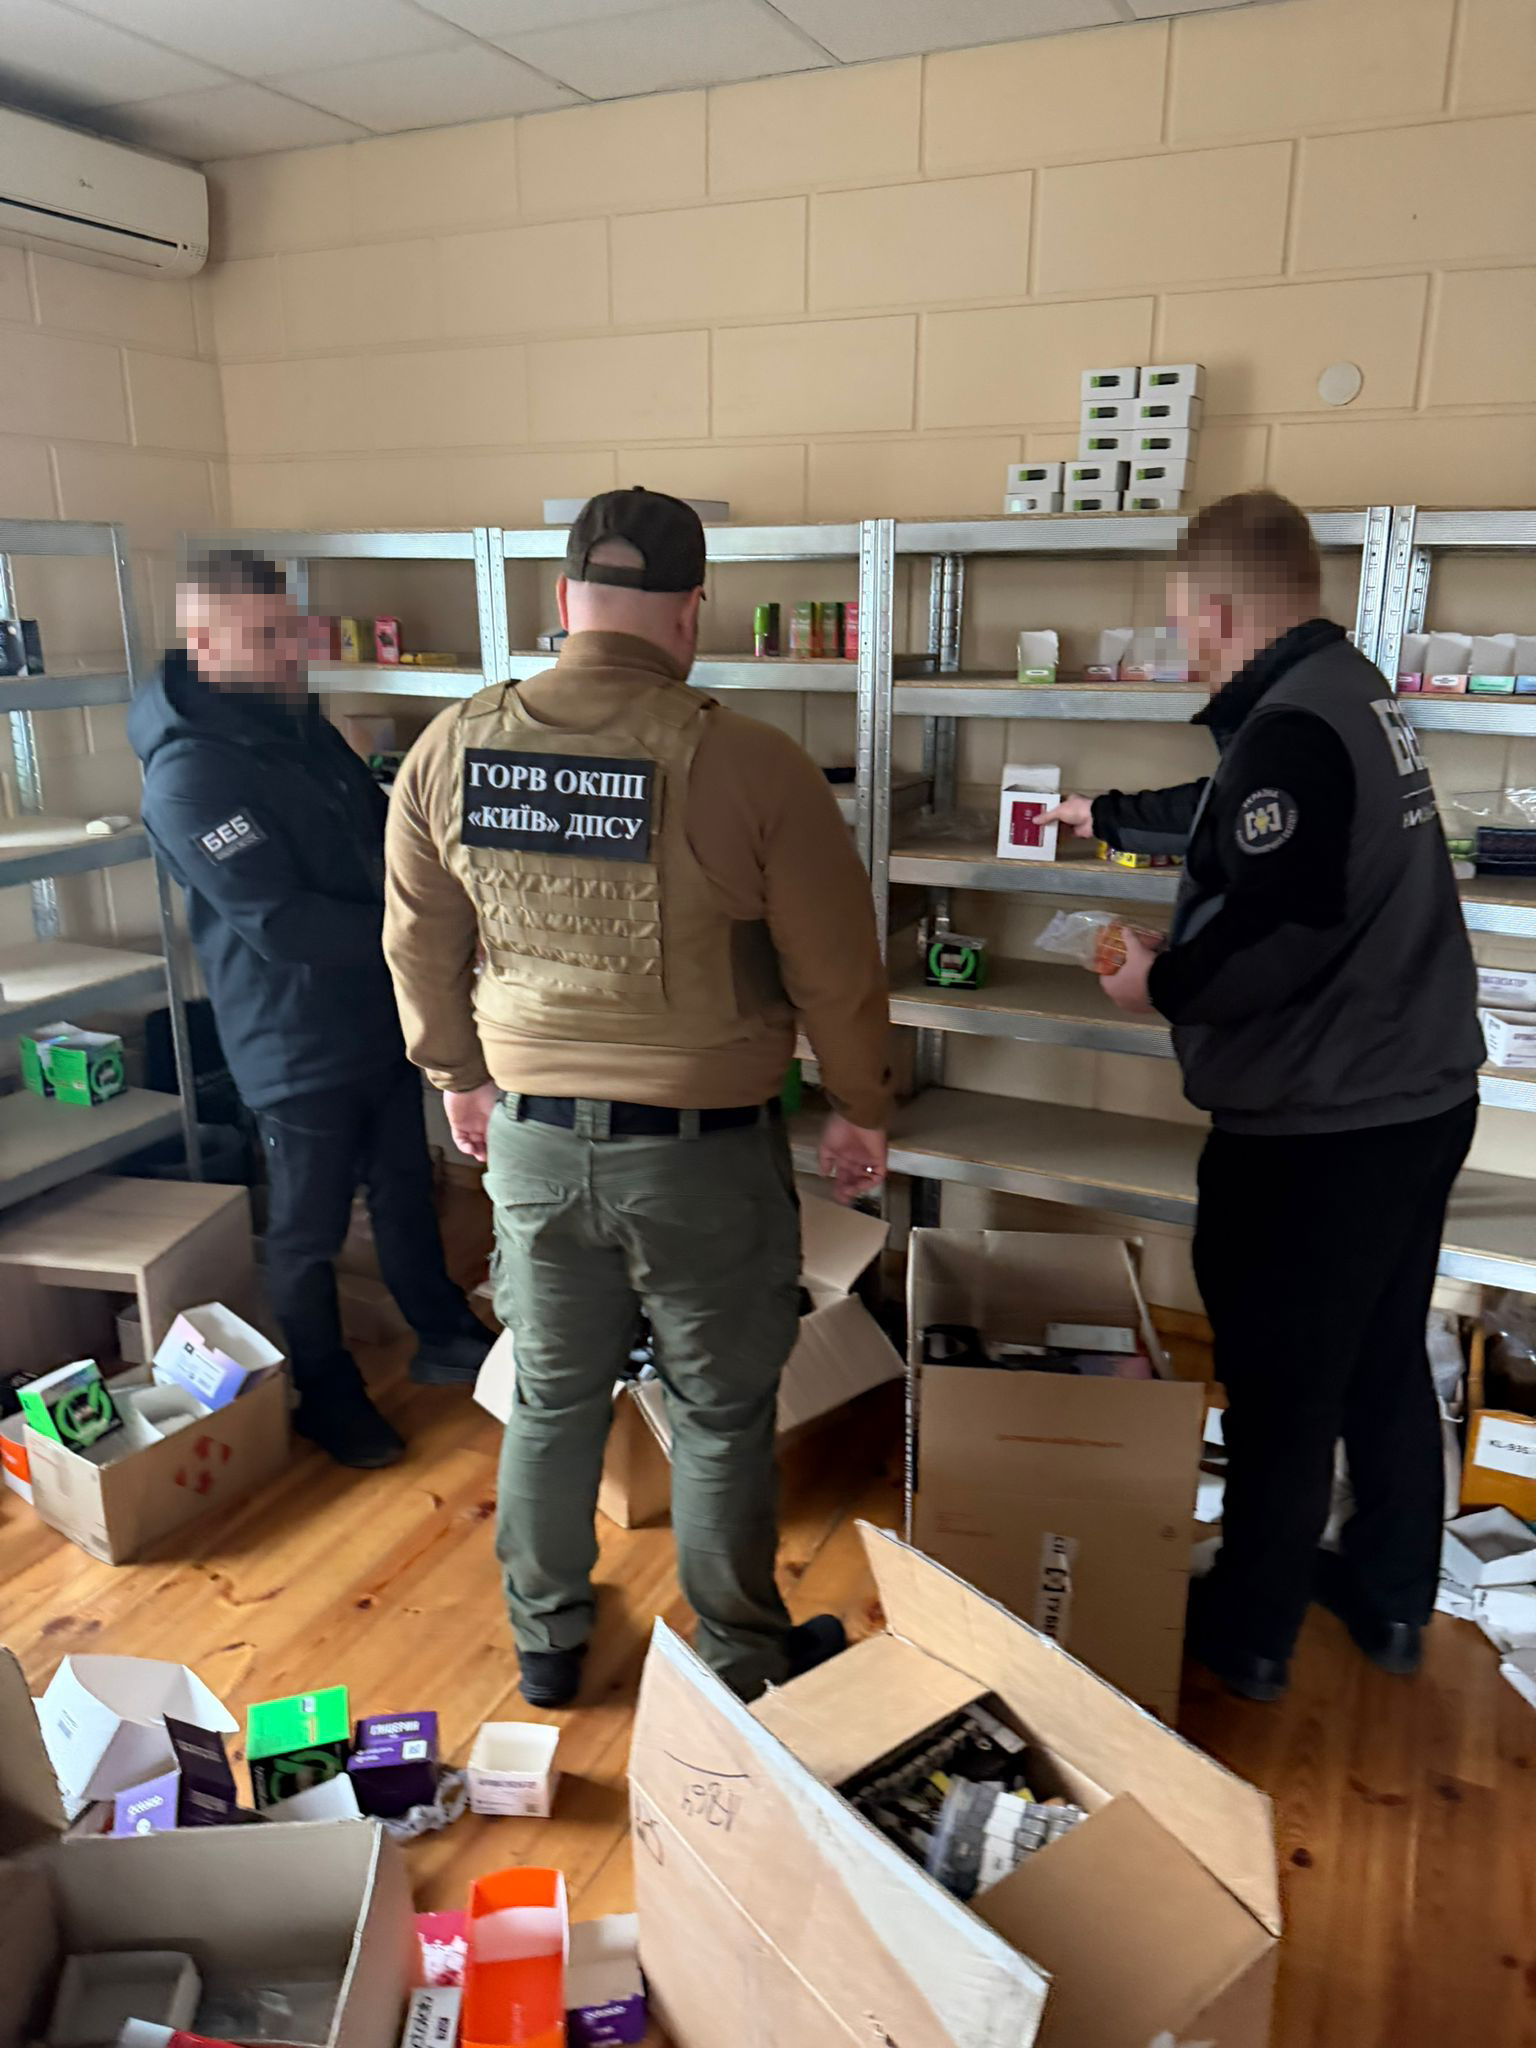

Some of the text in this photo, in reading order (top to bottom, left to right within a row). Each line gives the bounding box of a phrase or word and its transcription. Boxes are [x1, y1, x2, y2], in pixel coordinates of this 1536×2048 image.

[469, 761, 647, 800] ГОРВ ОКПП
[201, 814, 250, 853] БЕБ
[467, 803, 644, 841] «КИЇВ» ДПСУ
